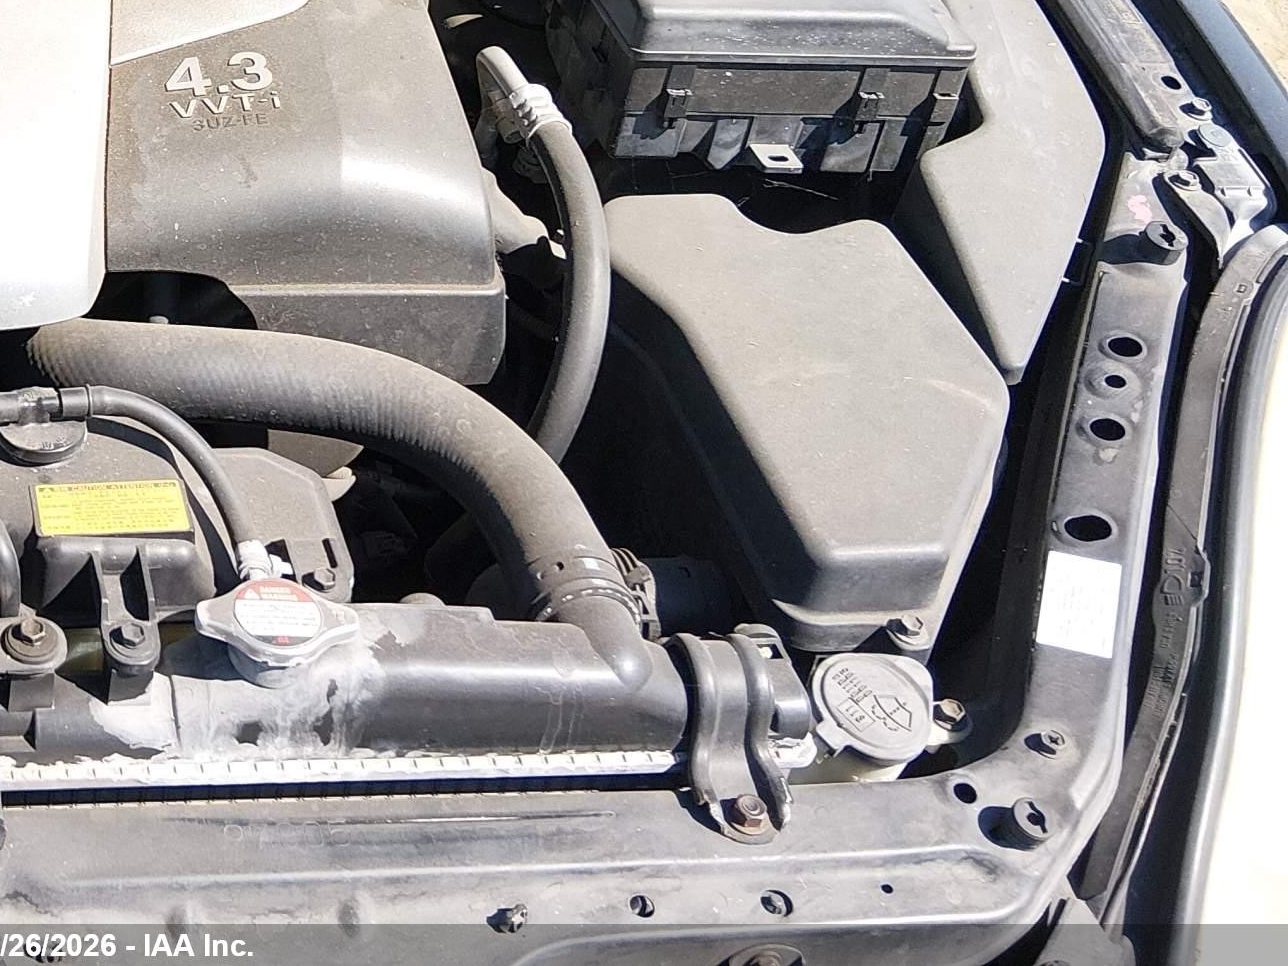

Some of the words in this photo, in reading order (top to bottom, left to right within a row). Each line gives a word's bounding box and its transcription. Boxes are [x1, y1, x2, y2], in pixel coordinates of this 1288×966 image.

[164, 51, 273, 98] 4.3
[169, 90, 281, 119] VVT-i
[192, 113, 269, 132] 3UZ-FE
